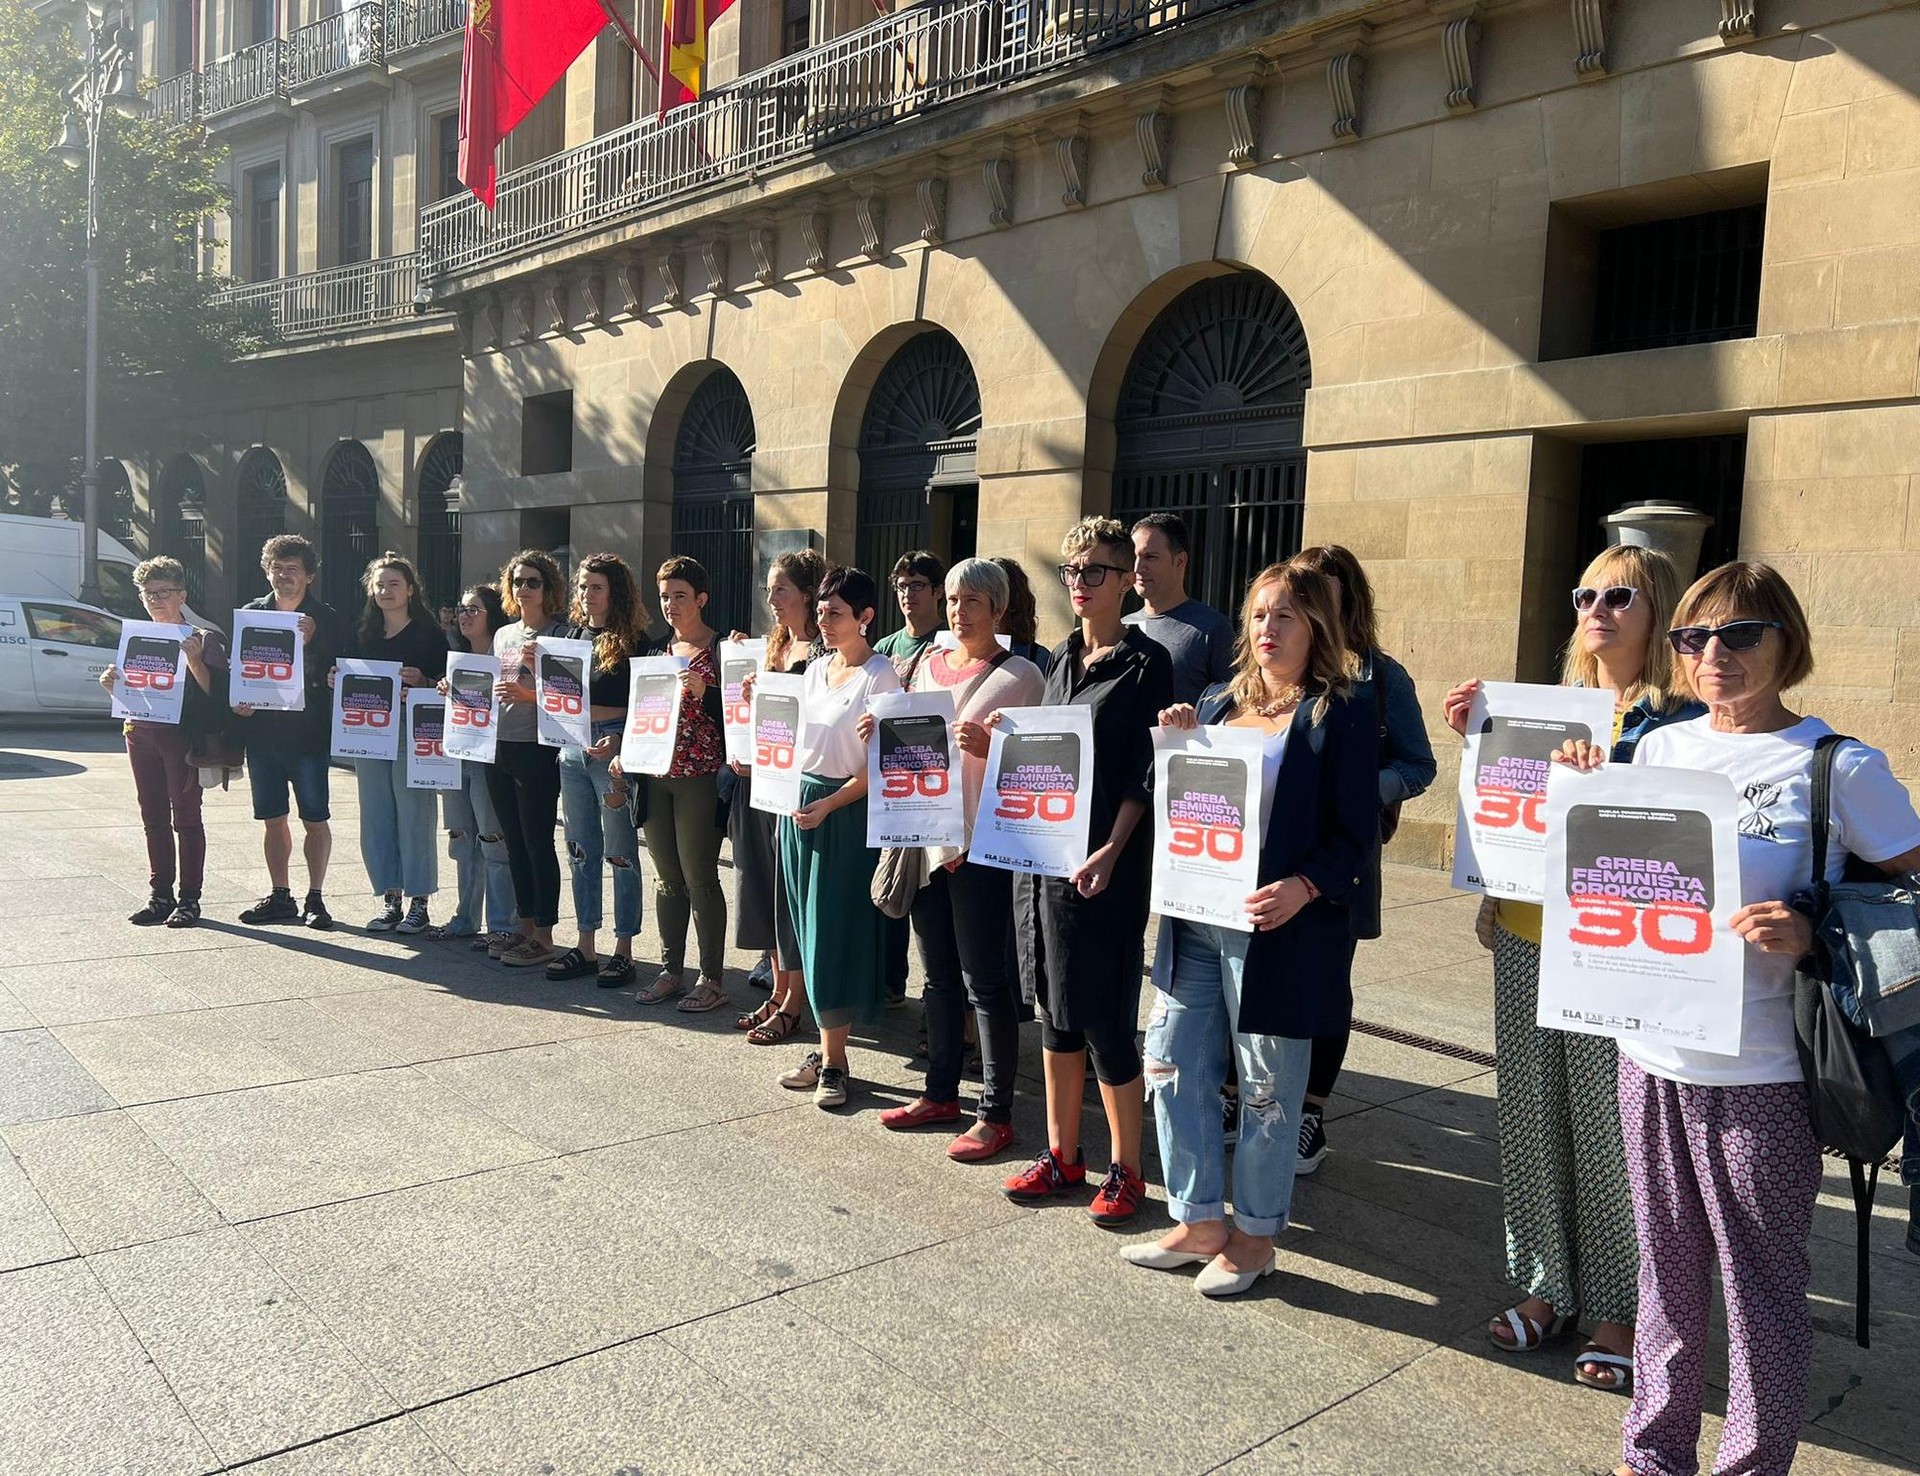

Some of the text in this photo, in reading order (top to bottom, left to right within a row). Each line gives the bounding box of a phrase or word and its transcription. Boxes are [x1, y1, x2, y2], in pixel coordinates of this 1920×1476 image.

[124, 669, 175, 690] 30
[241, 660, 292, 681] 30
[544, 692, 582, 714] 30
[342, 707, 390, 727] 30
[451, 705, 490, 728] 30
[631, 712, 671, 734] 30
[756, 742, 795, 769] 30
[882, 752, 945, 763] FEMINISTA
[894, 745, 933, 754] GREBA
[882, 761, 946, 770] OROKORRA
[1016, 765, 1062, 774] GREBA
[1497, 756, 1550, 770] GREB
[881, 768, 949, 799] 30
[1000, 781, 1074, 791] OROKORRA
[1001, 773, 1074, 782] FEMINISTA
[994, 788, 1075, 823] 30
[1183, 791, 1228, 805] GREBA
[1169, 810, 1241, 827] OROKORRA
[1170, 800, 1241, 817] FEMINISTA
[1168, 820, 1243, 862] 30
[1595, 856, 1680, 875] GREBA
[1572, 867, 1706, 891] FEMINISTA
[1571, 881, 1708, 905] OROKORRA
[1569, 893, 1713, 955] 30
[1562, 1009, 1582, 1020] ELA
